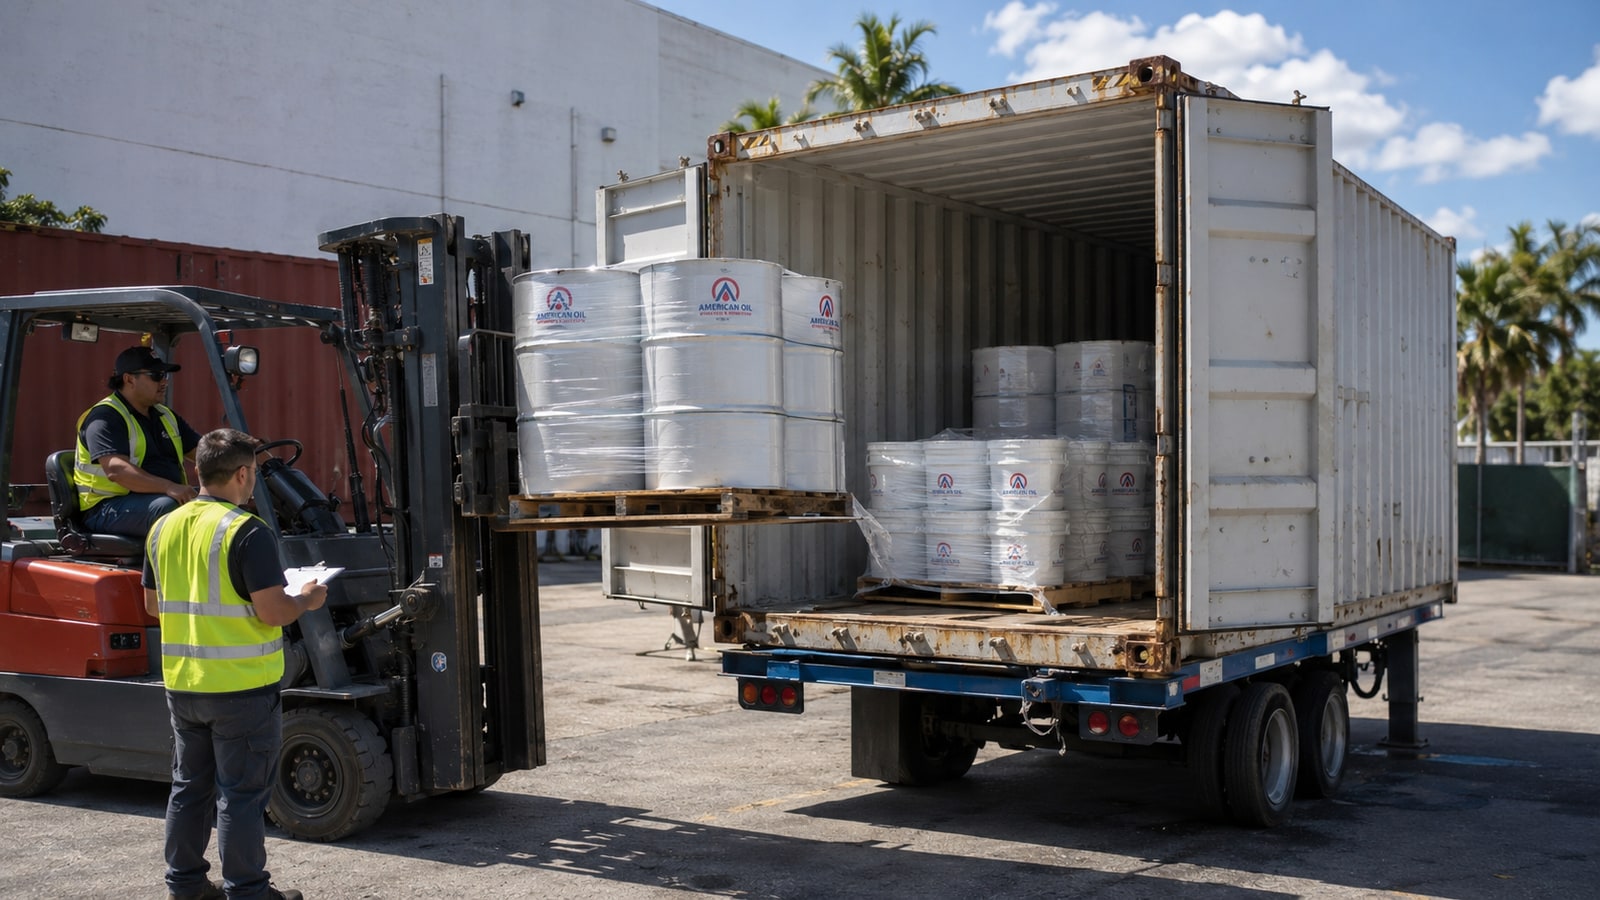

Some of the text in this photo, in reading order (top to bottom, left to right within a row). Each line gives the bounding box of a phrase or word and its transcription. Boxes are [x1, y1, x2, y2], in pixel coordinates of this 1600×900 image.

[698, 303, 753, 312] AMERICAN OIL
[536, 310, 587, 321] AMERICAN OIL
